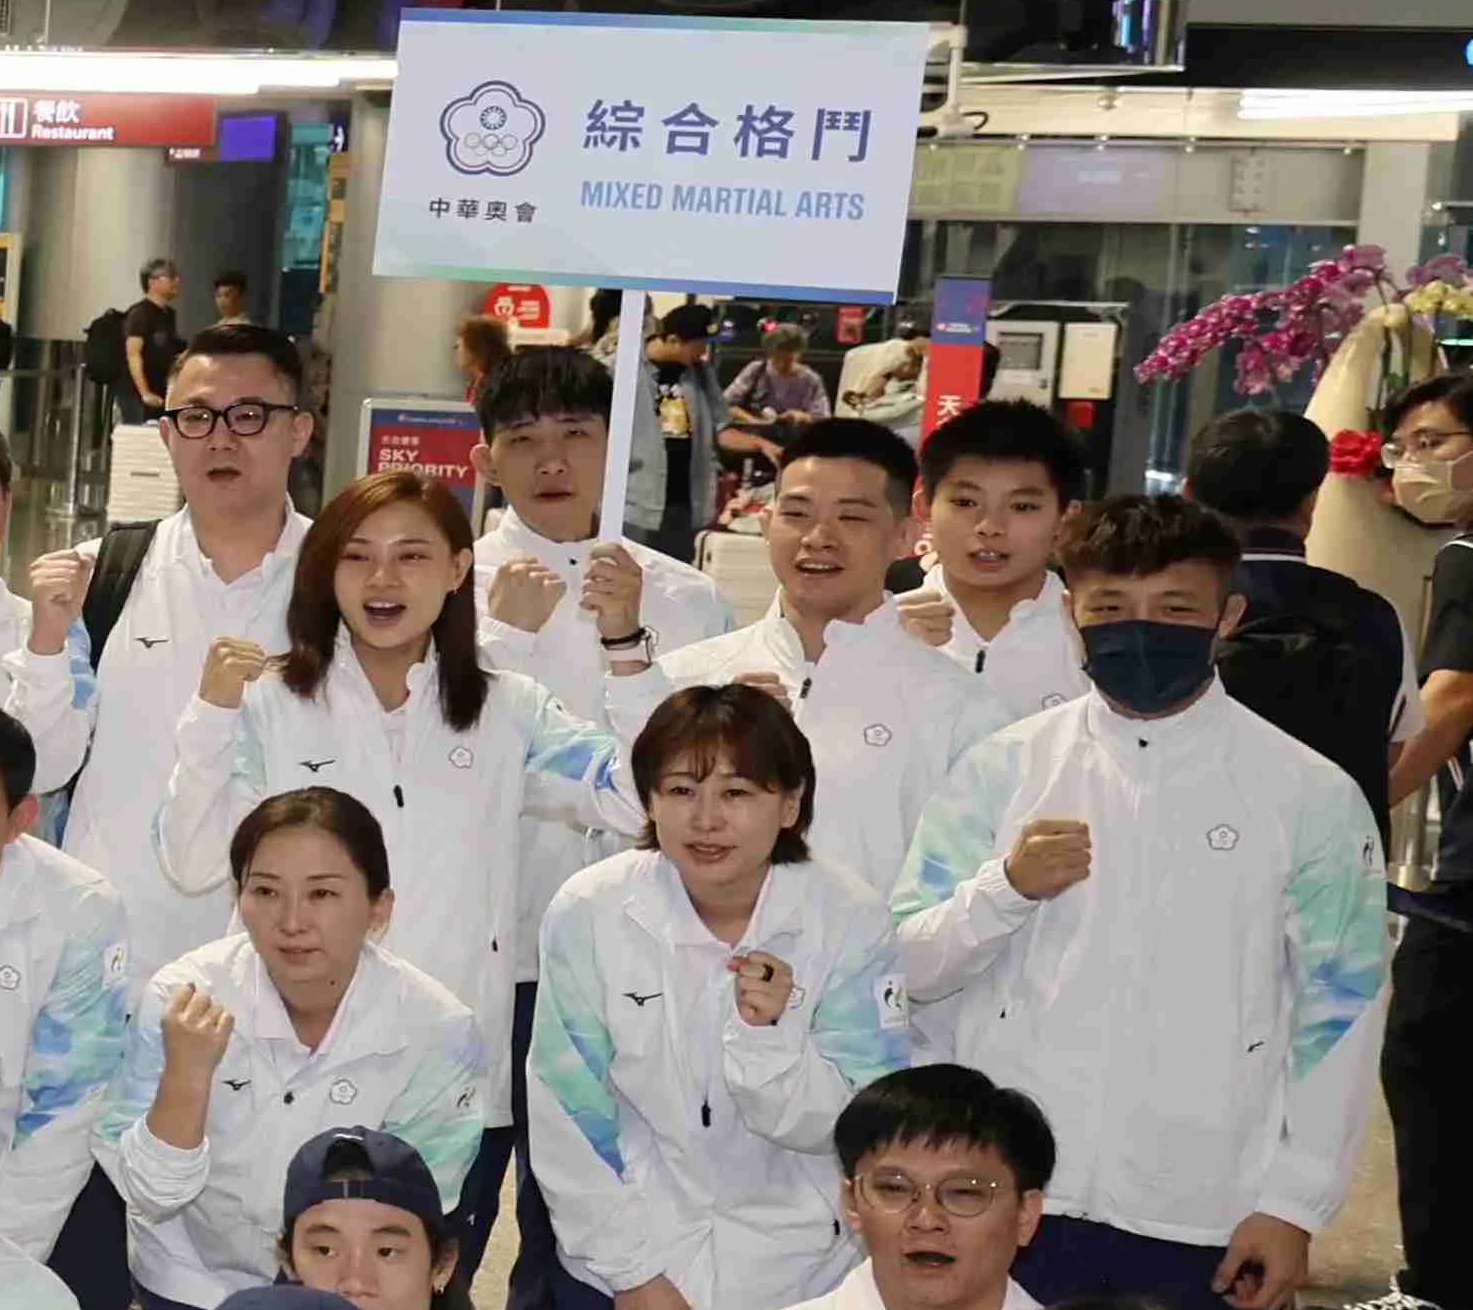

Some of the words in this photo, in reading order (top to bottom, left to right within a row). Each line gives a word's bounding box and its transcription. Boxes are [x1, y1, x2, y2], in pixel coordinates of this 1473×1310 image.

[33, 99, 80, 123] 餐飲
[31, 123, 114, 141] Restaurant
[583, 98, 873, 164] 綜合格鬥
[428, 197, 539, 224] 中華奧會
[581, 181, 664, 212] MIXED
[671, 185, 788, 219] MARTIAL
[794, 191, 866, 222] ARTS
[377, 448, 419, 462] SKY
